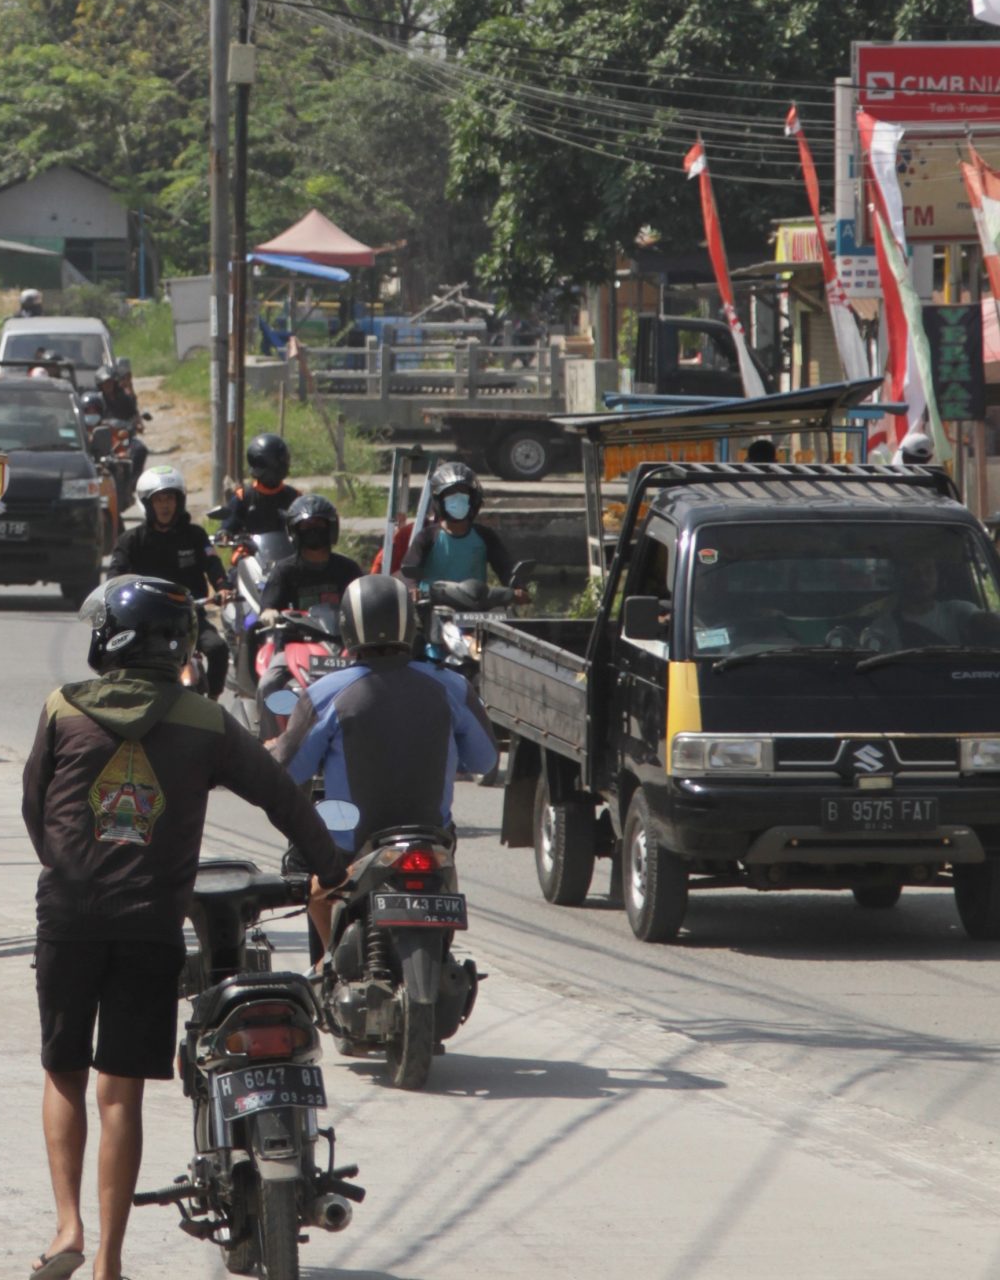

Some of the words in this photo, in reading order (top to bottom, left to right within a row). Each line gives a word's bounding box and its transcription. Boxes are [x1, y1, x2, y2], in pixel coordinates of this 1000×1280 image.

[900, 75, 965, 96] CIMB
[929, 102, 956, 114] Tarik
[959, 103, 988, 114] Tunai
[902, 205, 934, 226] TM
[827, 801, 839, 821] B
[852, 800, 894, 821] 9575
[901, 800, 933, 821] FAT
[377, 897, 386, 910] B
[435, 899, 461, 911] FVK
[221, 1077, 233, 1096] H
[244, 1067, 286, 1089] 6047
